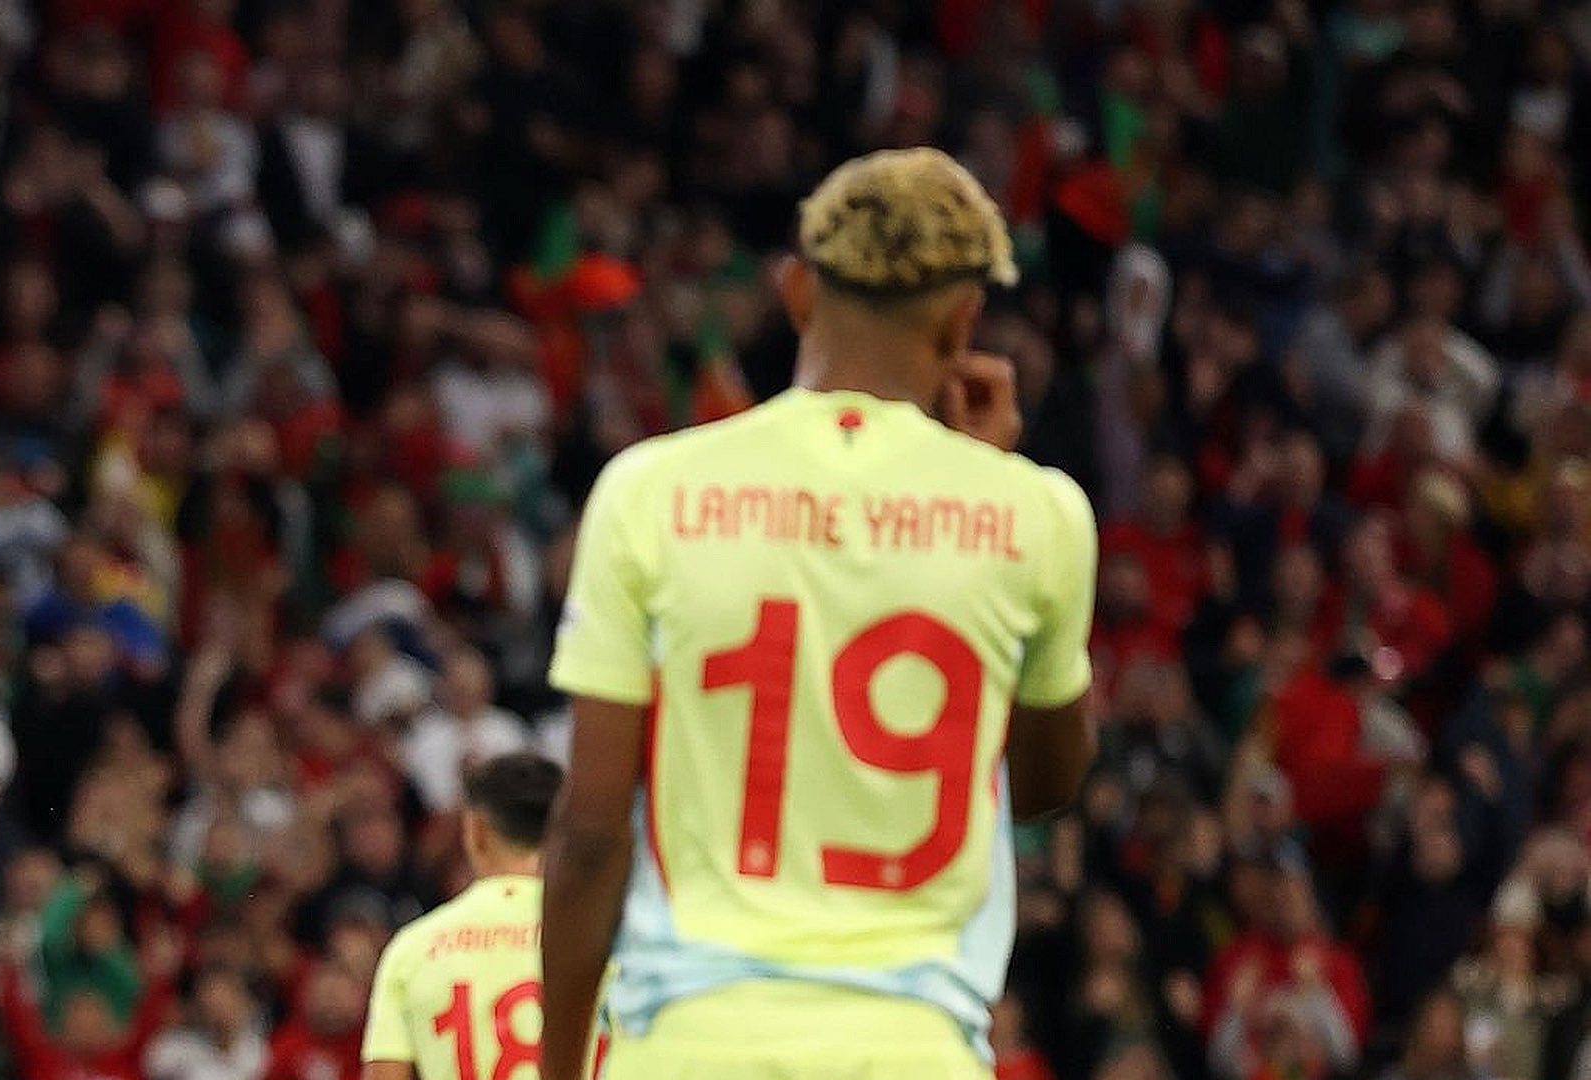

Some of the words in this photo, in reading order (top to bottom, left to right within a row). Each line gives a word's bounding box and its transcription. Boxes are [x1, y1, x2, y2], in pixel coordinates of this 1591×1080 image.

[673, 484, 842, 549] LAMINE
[861, 497, 1025, 562] YAMAL
[702, 598, 984, 893] 19
